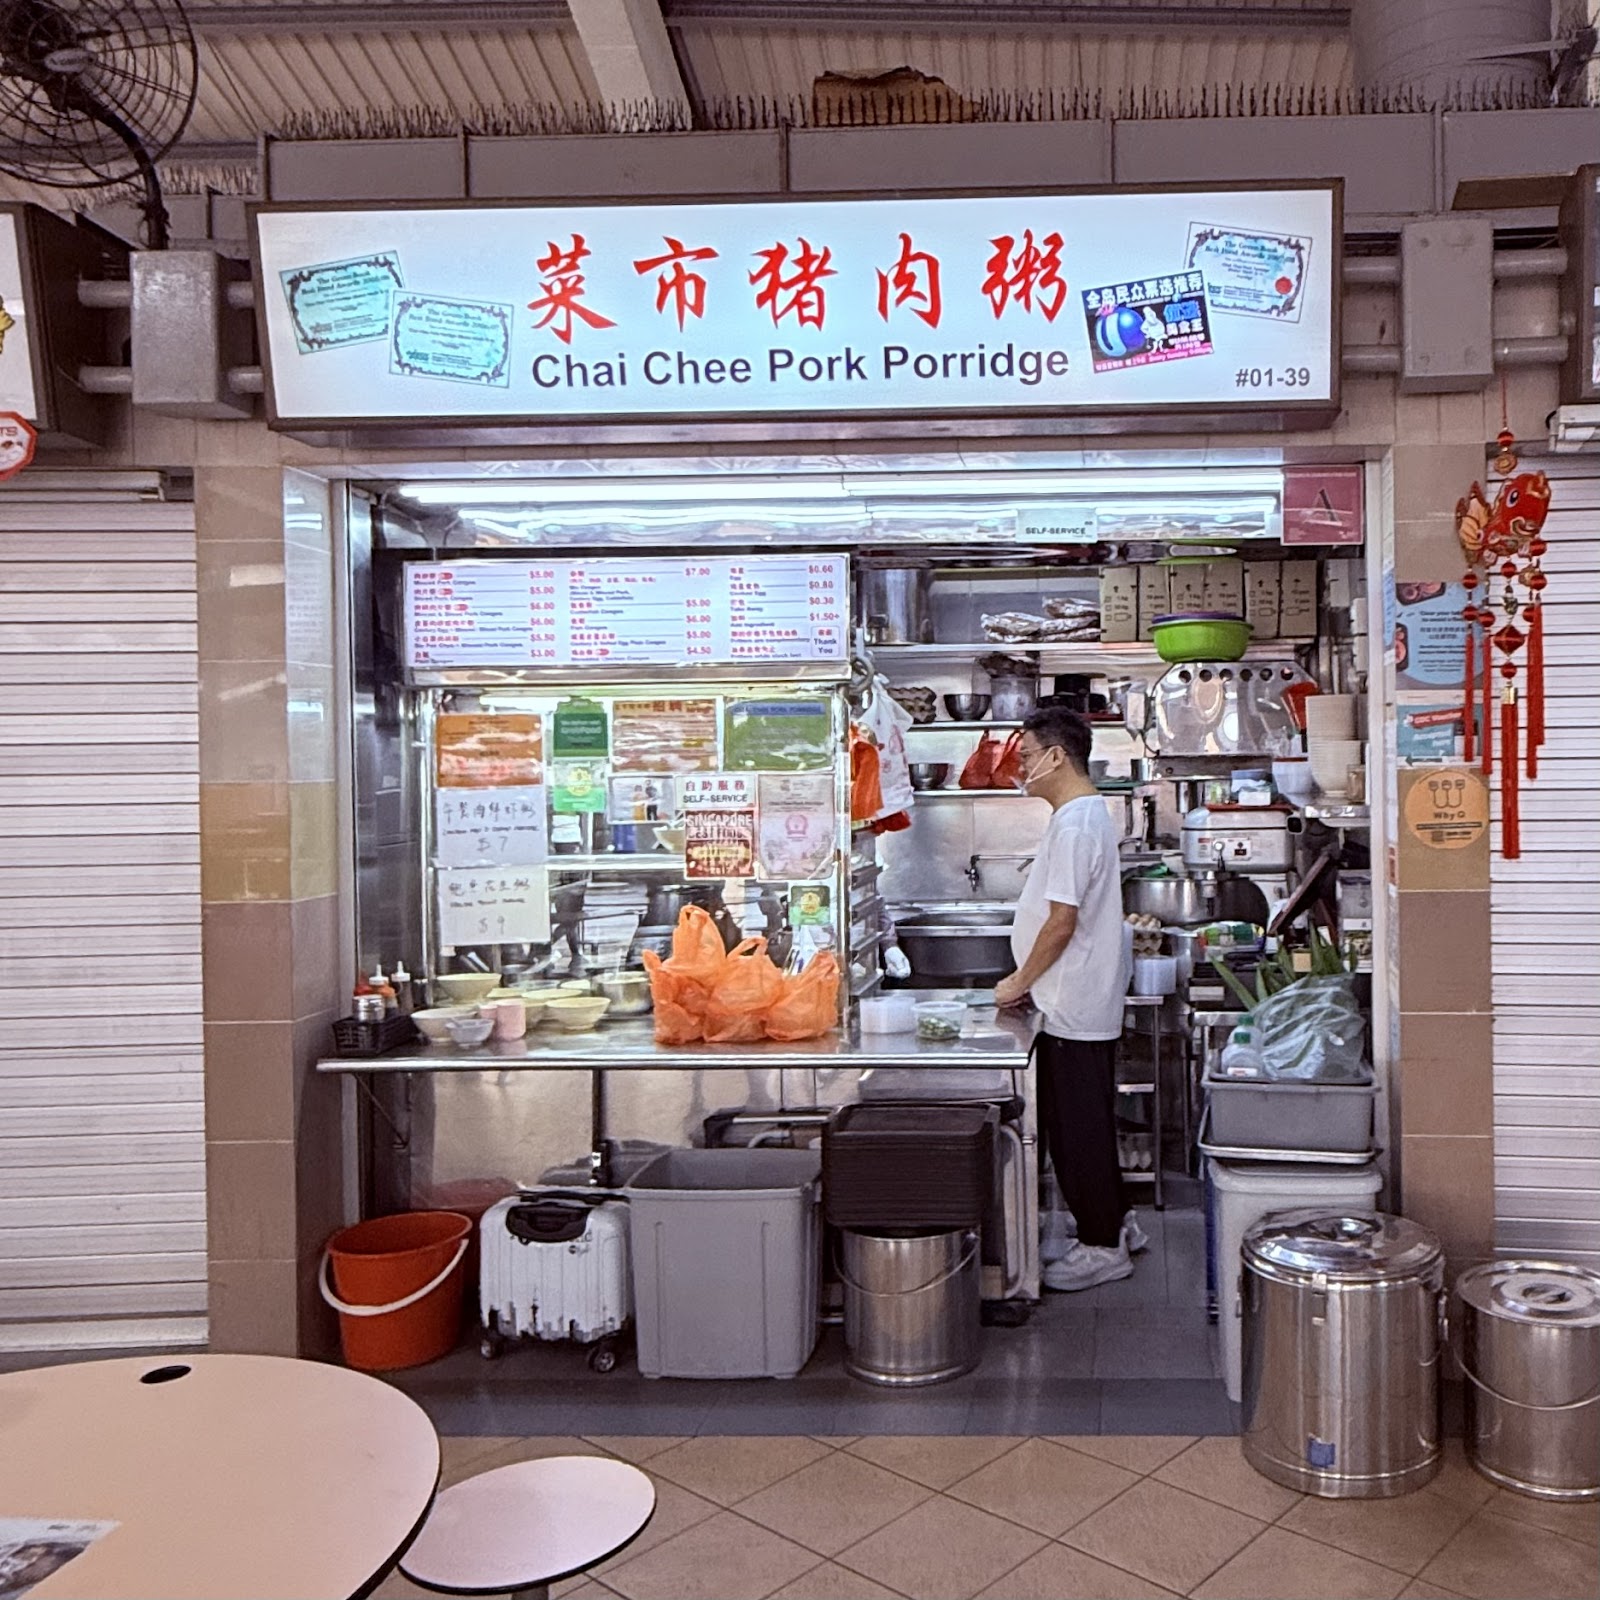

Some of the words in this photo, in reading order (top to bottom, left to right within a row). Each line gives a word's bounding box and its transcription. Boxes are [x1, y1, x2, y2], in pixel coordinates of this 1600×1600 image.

[528, 229, 1068, 345] 菜市猪肉粥
[532, 352, 627, 388] Chai
[643, 350, 751, 386] Chee
[769, 347, 868, 383] Pork
[883, 343, 1068, 386] Porridge
[1235, 367, 1311, 388] #01-39
[1025, 527, 1086, 535] SELF-SERVICE
[685, 568, 710, 576] $7.00
[809, 565, 833, 574] $0.60
[530, 570, 554, 579] $5.00
[530, 586, 554, 594] $5.00
[683, 794, 749, 803] SELF-SERVICE
